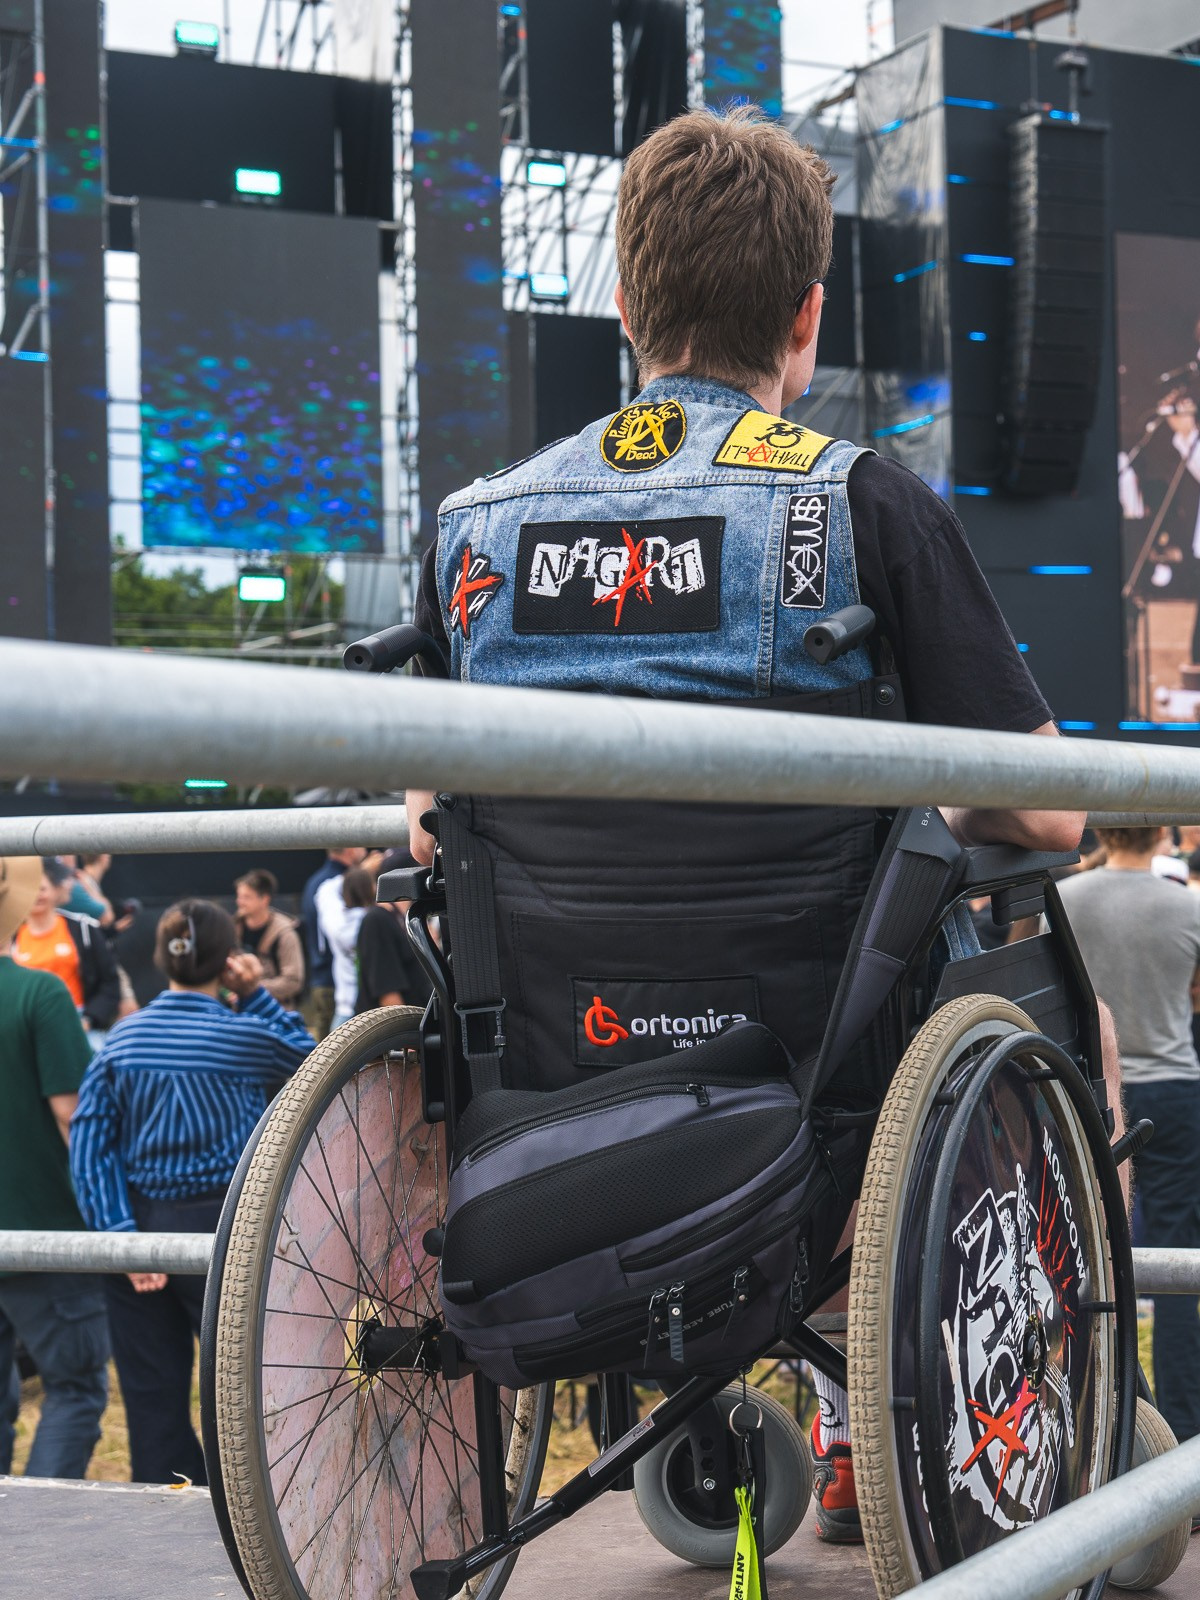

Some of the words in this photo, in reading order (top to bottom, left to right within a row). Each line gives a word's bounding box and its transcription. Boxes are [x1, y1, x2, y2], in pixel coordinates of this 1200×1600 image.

[625, 446, 657, 461] Dead
[672, 1038, 694, 1049] Life
[1042, 1125, 1087, 1281] MOSCOW
